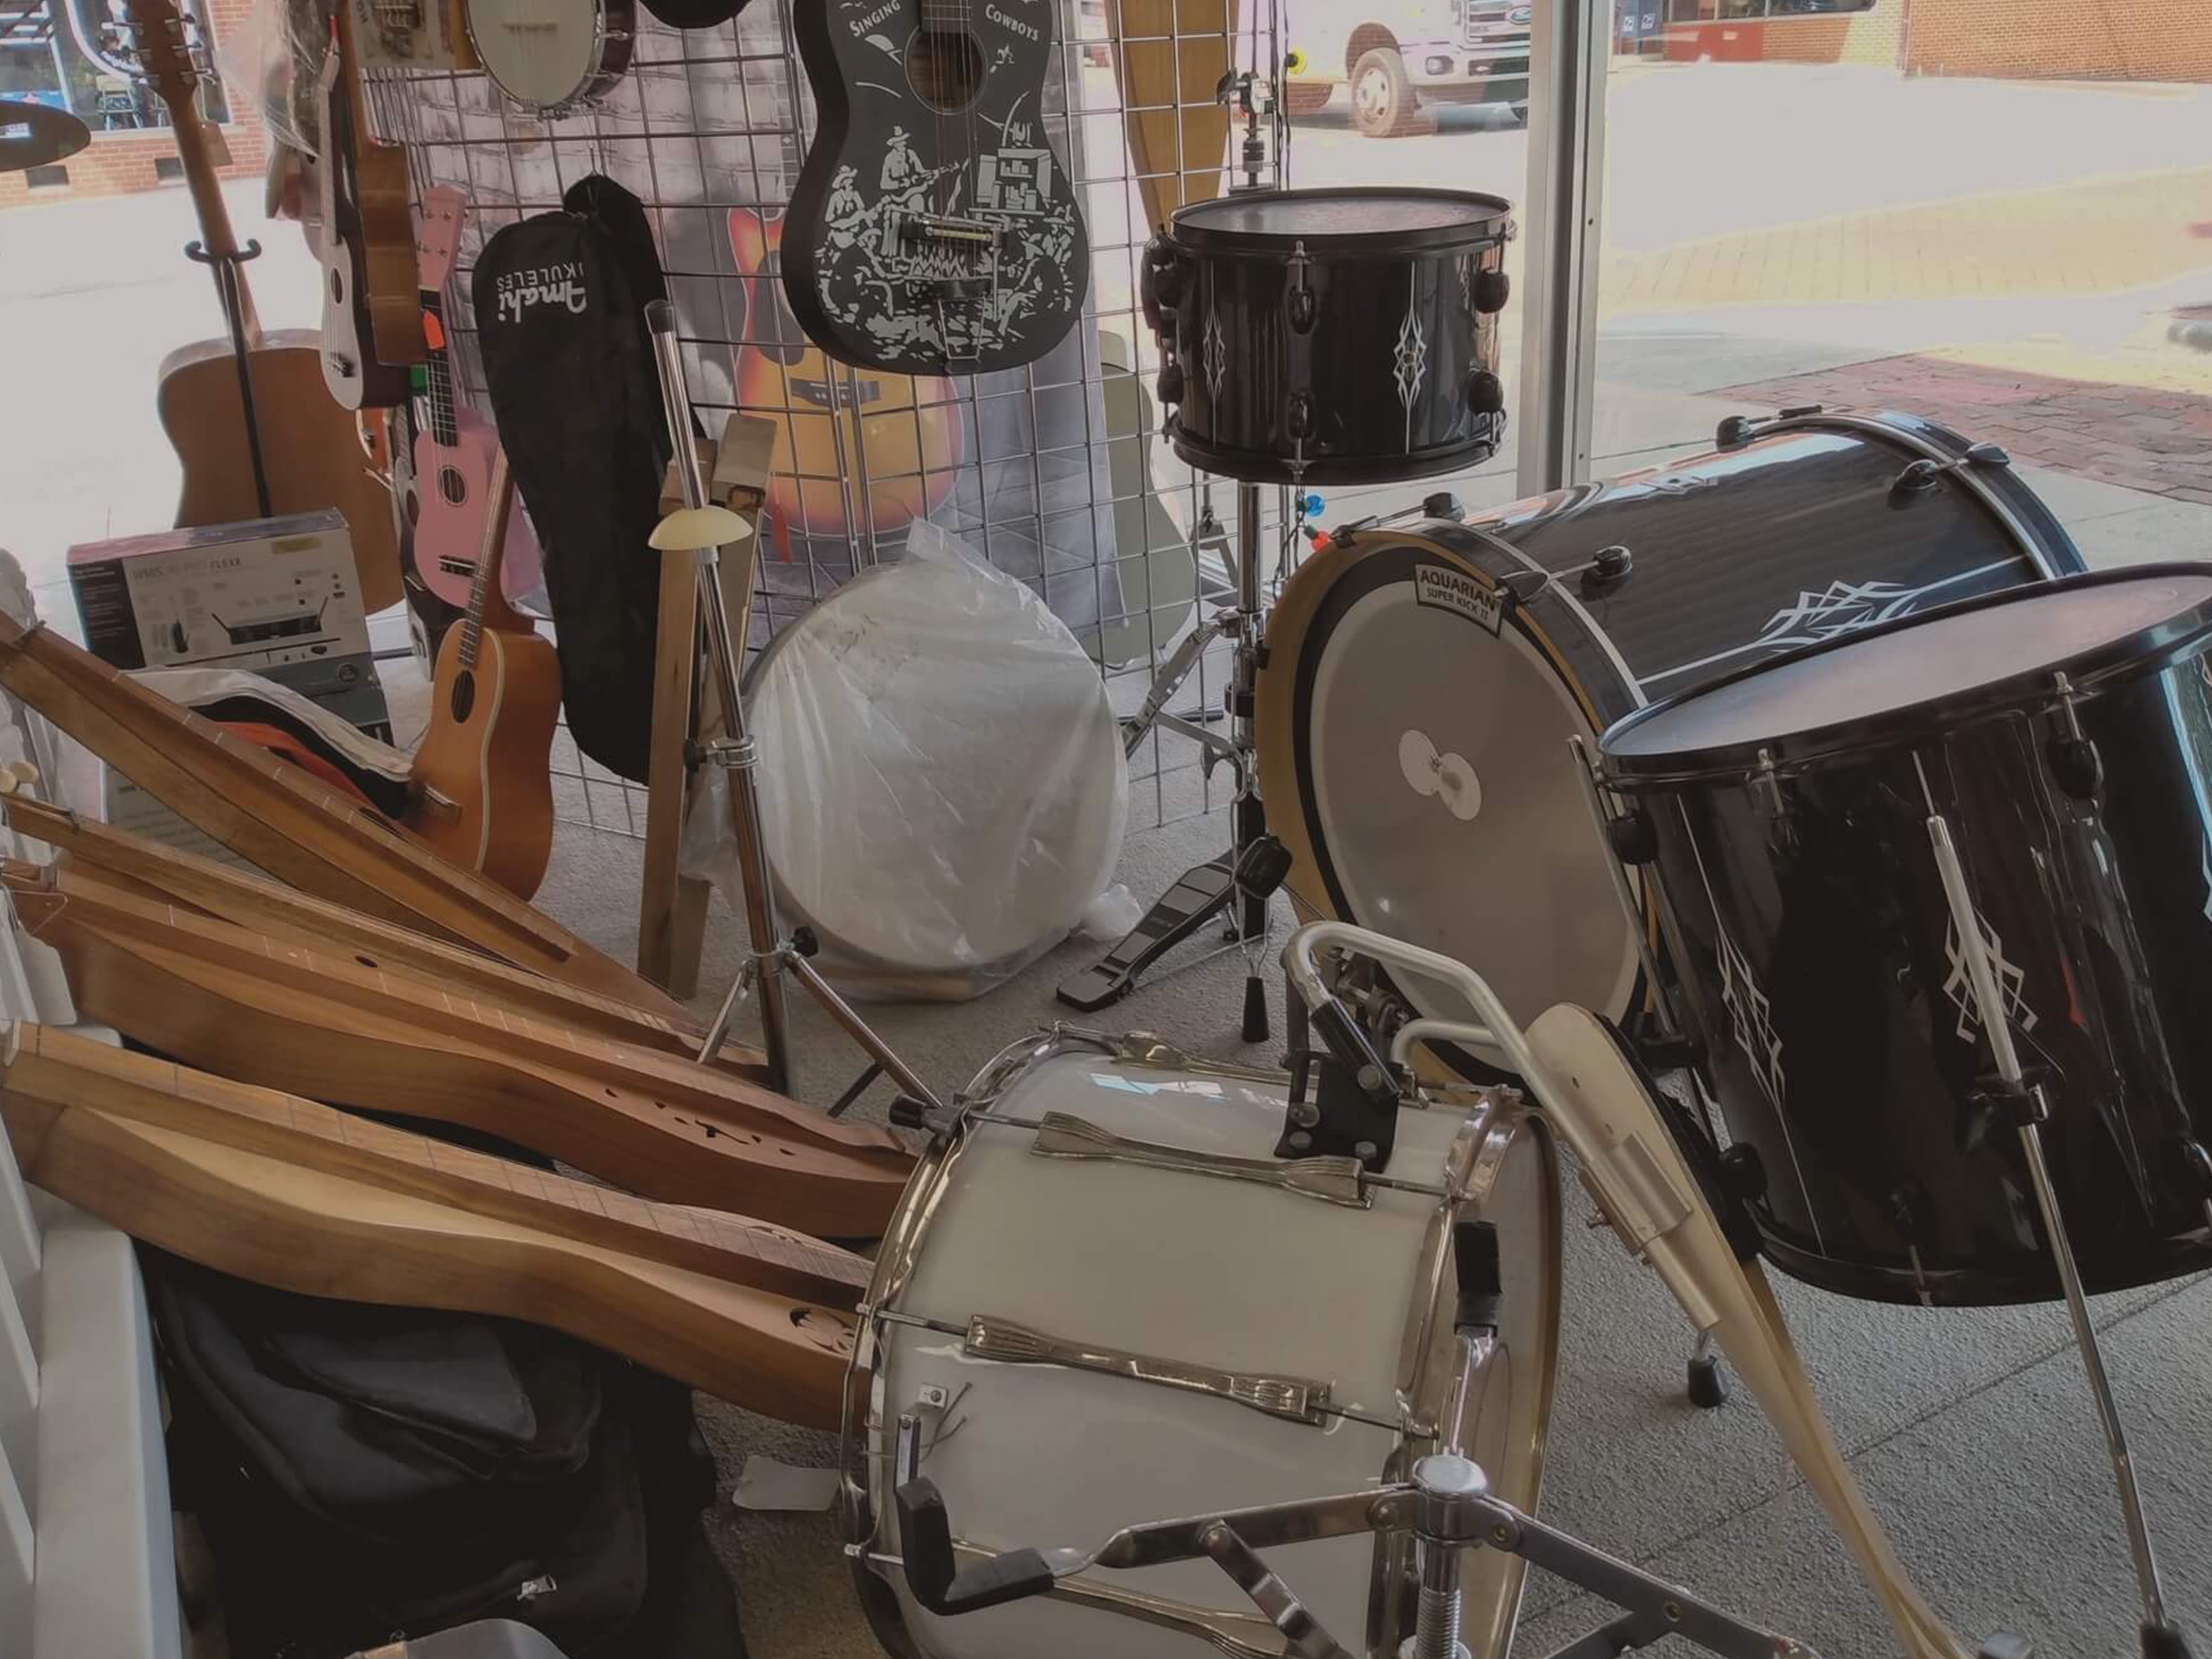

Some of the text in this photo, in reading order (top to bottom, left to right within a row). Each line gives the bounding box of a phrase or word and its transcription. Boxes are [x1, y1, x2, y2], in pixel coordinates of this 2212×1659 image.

[849, 0, 1040, 41] SINGING COWBOYS
[498, 280, 587, 323] Amahi
[1420, 570, 1495, 611] AQUARIAN
[1427, 588, 1454, 603] SUPER
[1457, 597, 1477, 614] KICK
